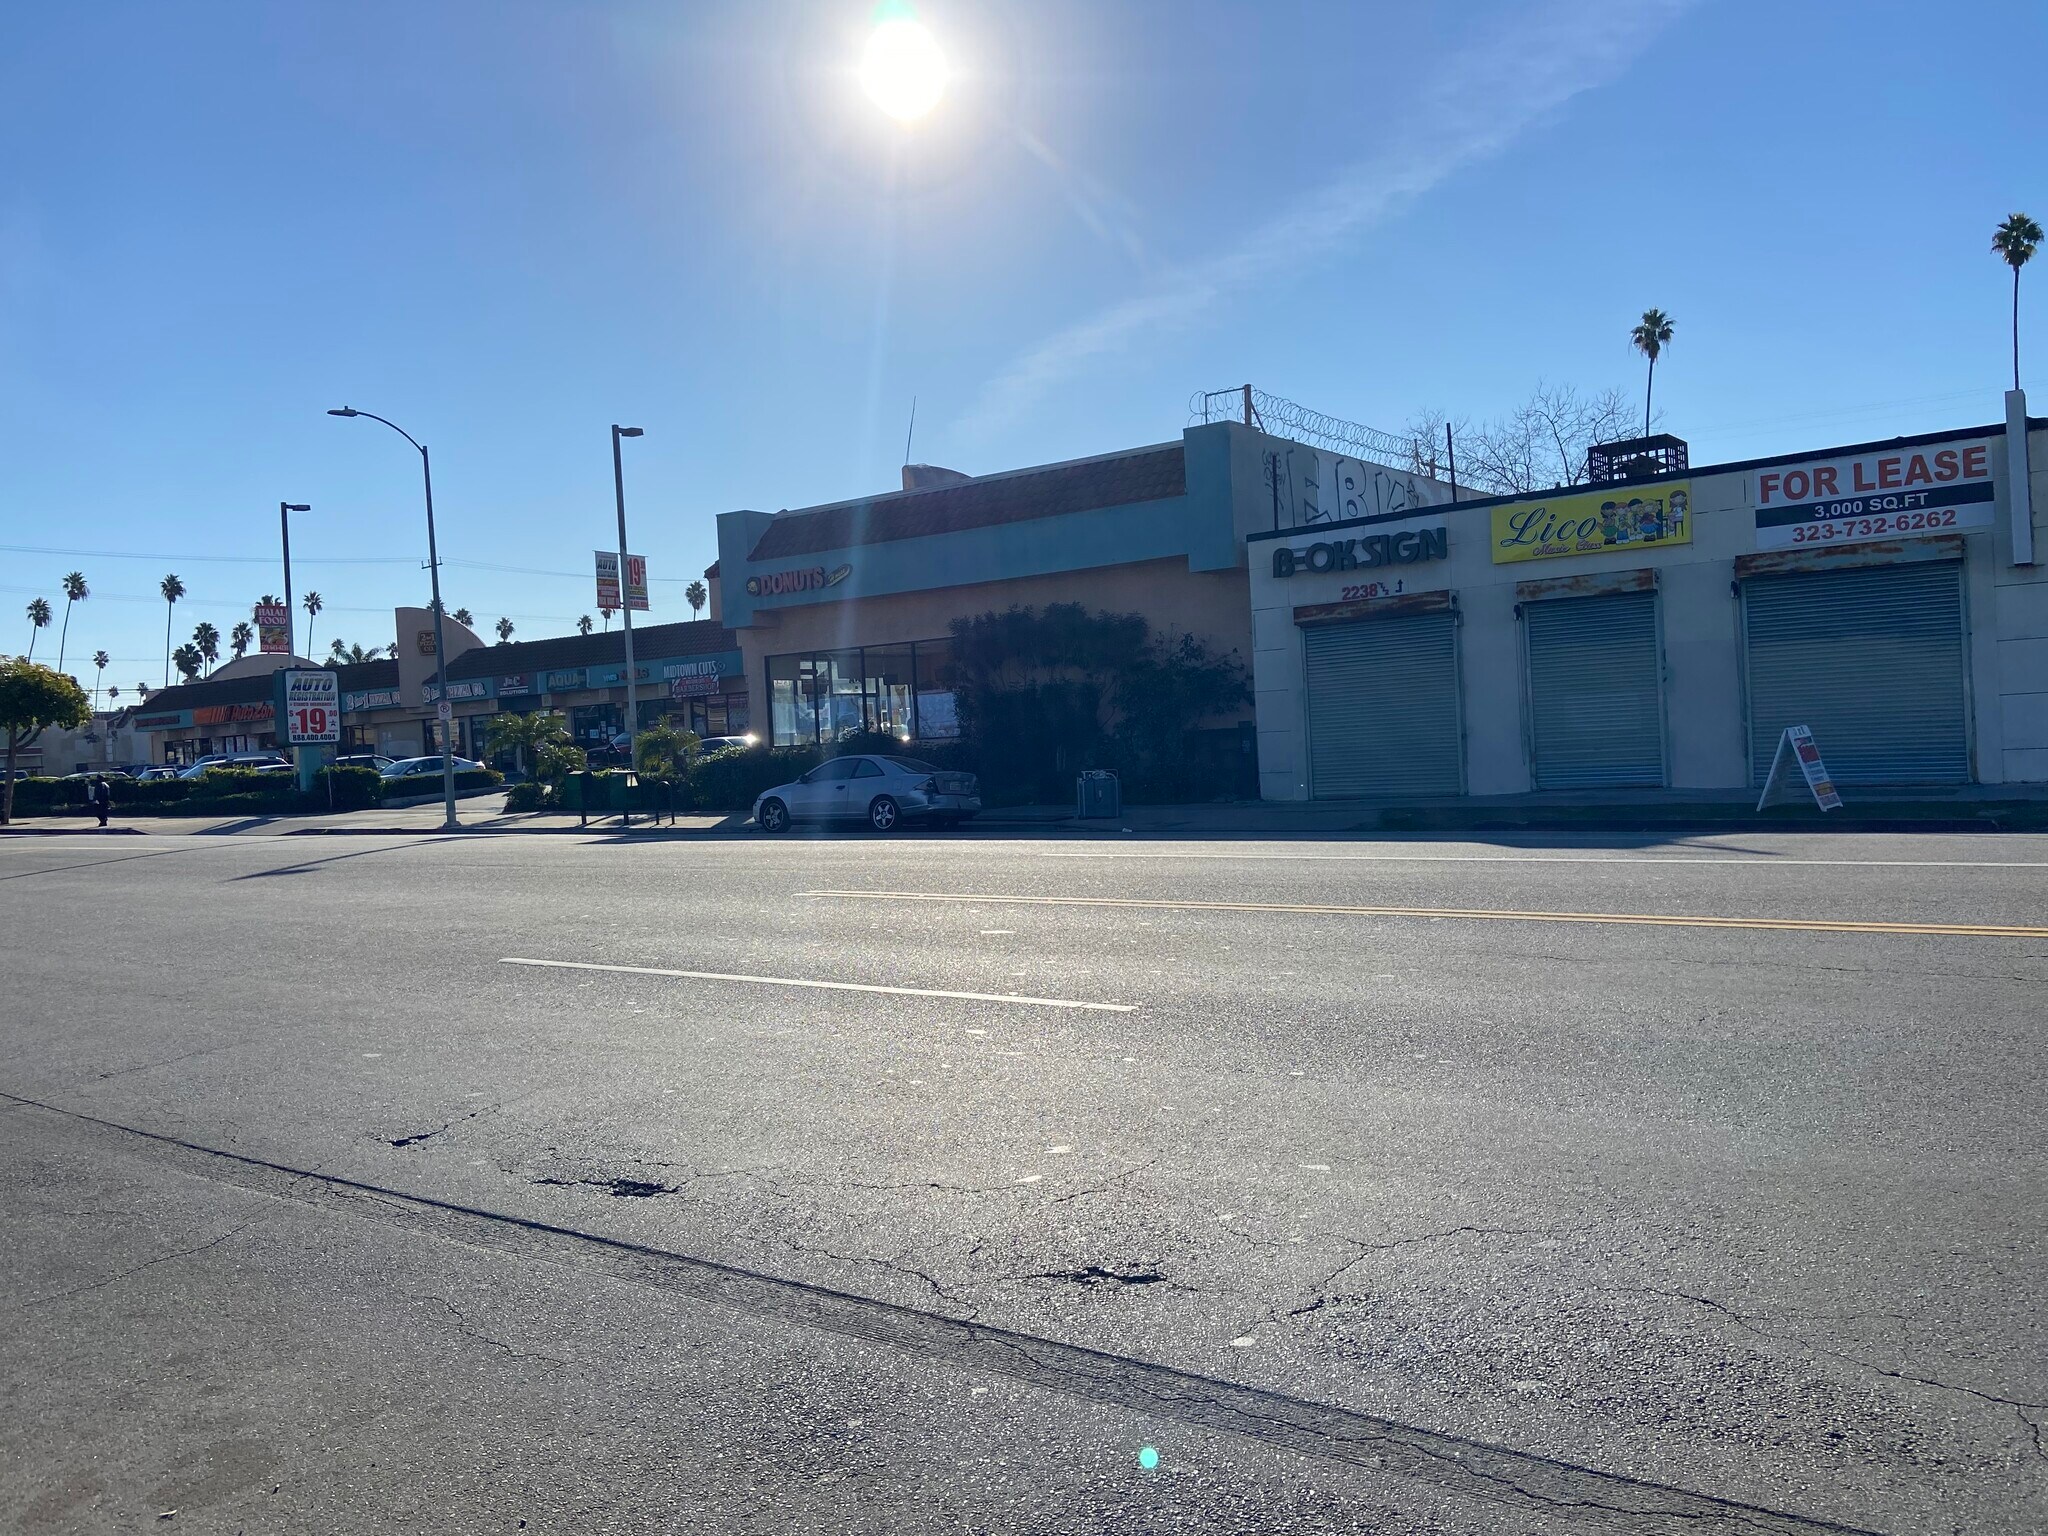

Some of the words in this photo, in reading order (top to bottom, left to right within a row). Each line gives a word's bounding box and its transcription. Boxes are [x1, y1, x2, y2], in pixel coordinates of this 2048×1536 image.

[1760, 465, 1840, 504] FOR
[1853, 445, 1988, 493] LEASE
[1814, 501, 1864, 519] 3,000
[1869, 492, 1929, 511] SQ.FT
[1499, 507, 1598, 548] Lico
[1792, 509, 1957, 543] 323-732-6262
[597, 559, 617, 571] AUTO
[760, 567, 825, 596] DONUTS
[1342, 583, 1379, 601] 2238
[259, 608, 286, 616] HALAL
[259, 616, 286, 625] FOOD
[663, 663, 697, 679] MIDTOWN
[698, 660, 718, 676] CUTS
[290, 678, 334, 691] AUTO
[548, 673, 580, 688] AQUA
[288, 691, 337, 702] REGISTRATION
[369, 692, 393, 707] PIZZA
[446, 684, 472, 700] PIZZA
[499, 688, 529, 696] SOLUTIONS
[231, 702, 275, 721] AutoZon
